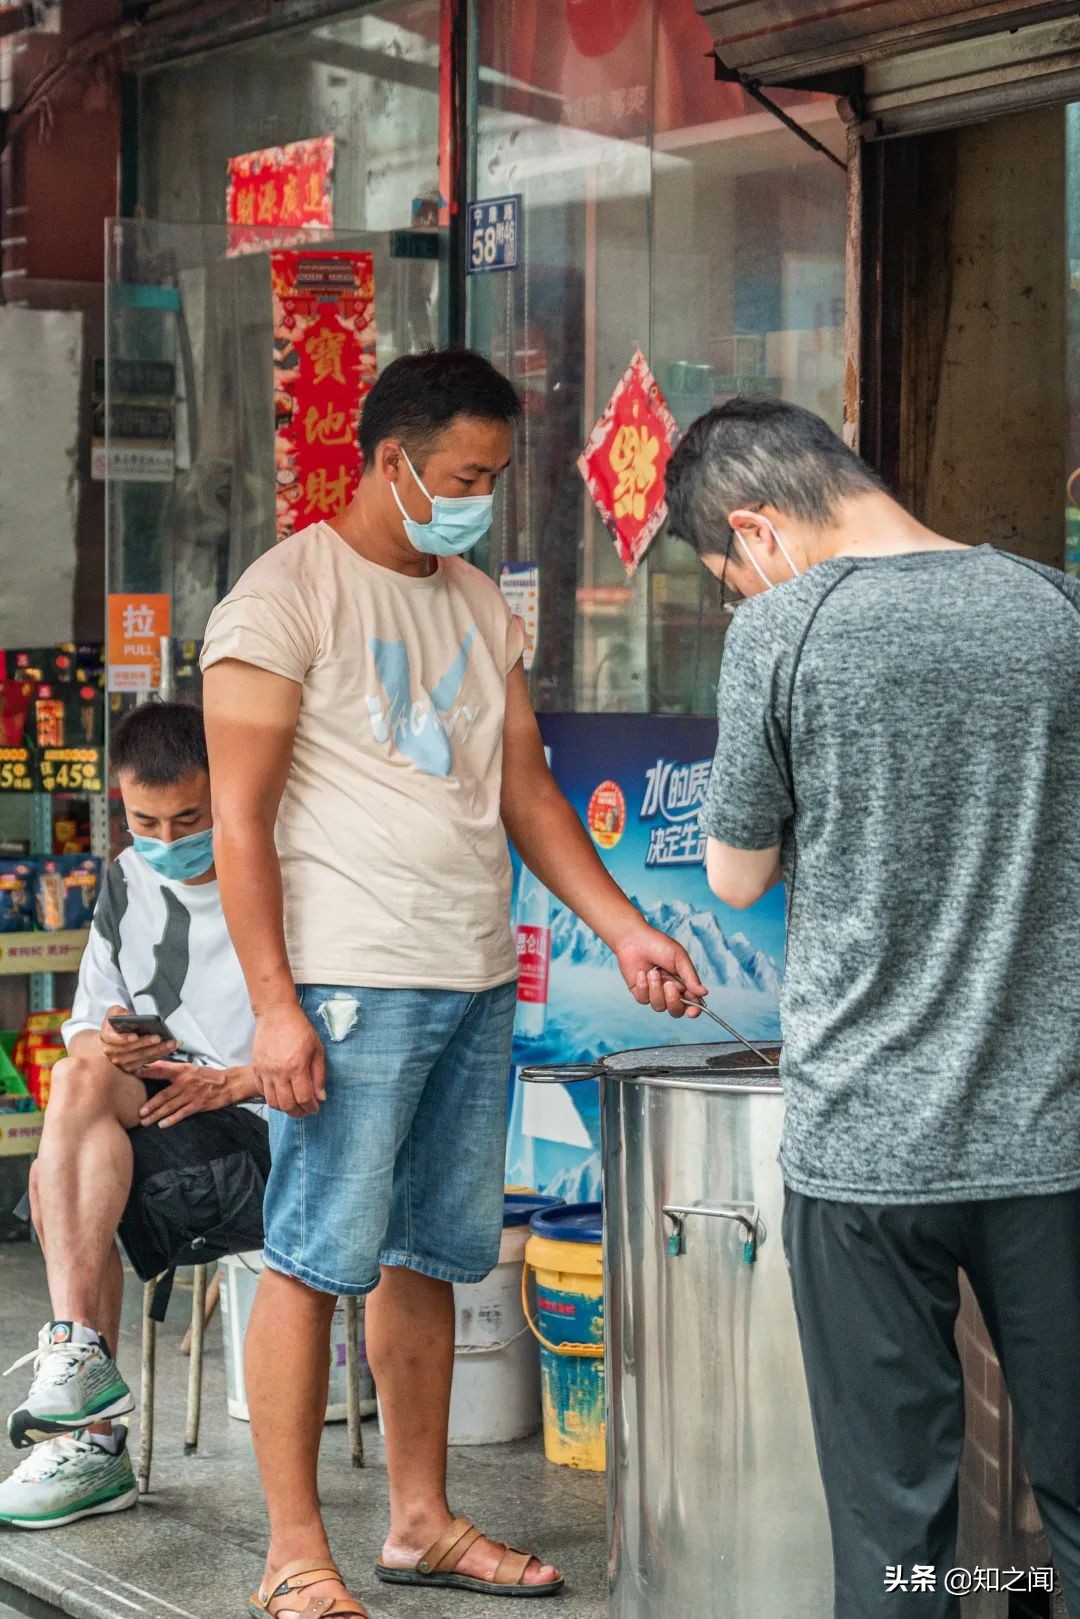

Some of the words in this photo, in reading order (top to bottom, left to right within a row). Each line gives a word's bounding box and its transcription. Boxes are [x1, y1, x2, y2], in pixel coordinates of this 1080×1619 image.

[122, 604, 155, 639] 拉
[124, 644, 154, 656] PULL
[56, 764, 83, 787] 45
